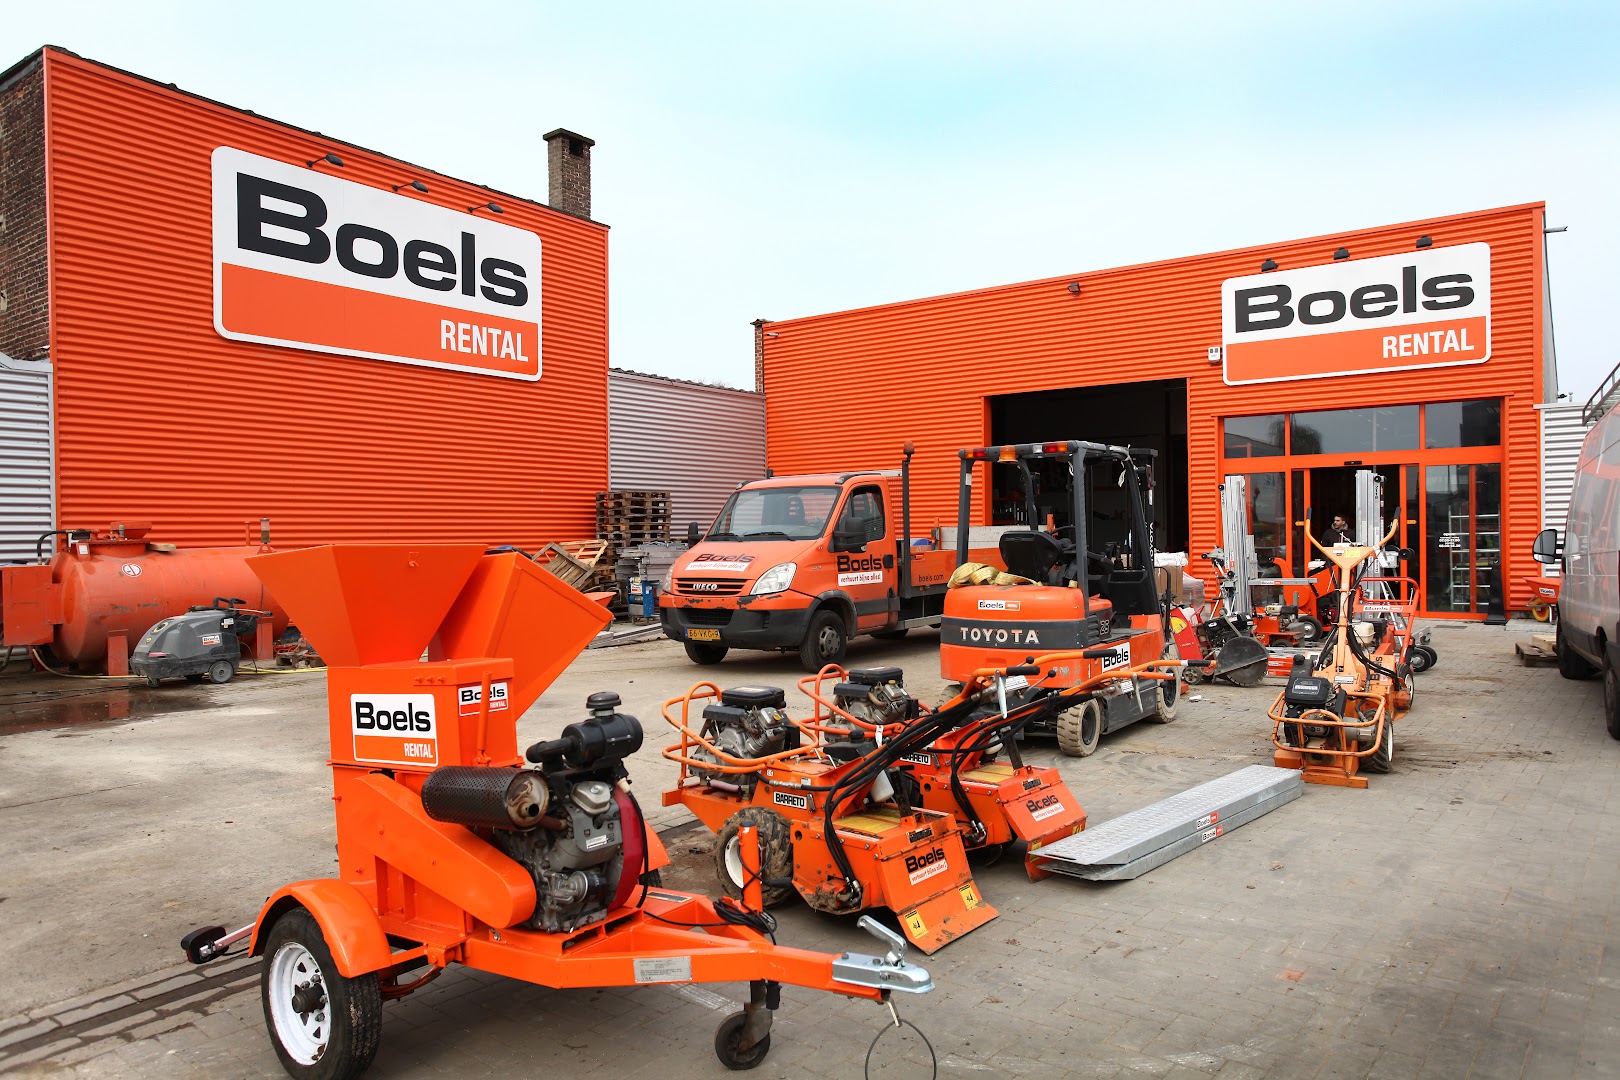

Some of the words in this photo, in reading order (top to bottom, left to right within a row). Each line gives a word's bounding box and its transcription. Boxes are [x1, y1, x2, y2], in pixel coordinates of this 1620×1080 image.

[236, 171, 529, 307] Boels
[1234, 265, 1475, 333] Boels
[440, 319, 529, 362] RENTAL
[1382, 327, 1475, 359] RENTAL
[693, 553, 756, 563] Boels
[836, 554, 883, 572] Boels
[692, 583, 718, 591] IVECO
[979, 601, 1004, 609] Boels
[960, 626, 1040, 645] TOYOTA
[355, 701, 431, 732] Boels
[404, 742, 434, 759] RENTAL
[775, 792, 805, 808] BARRETO
[905, 848, 945, 873] Boels
